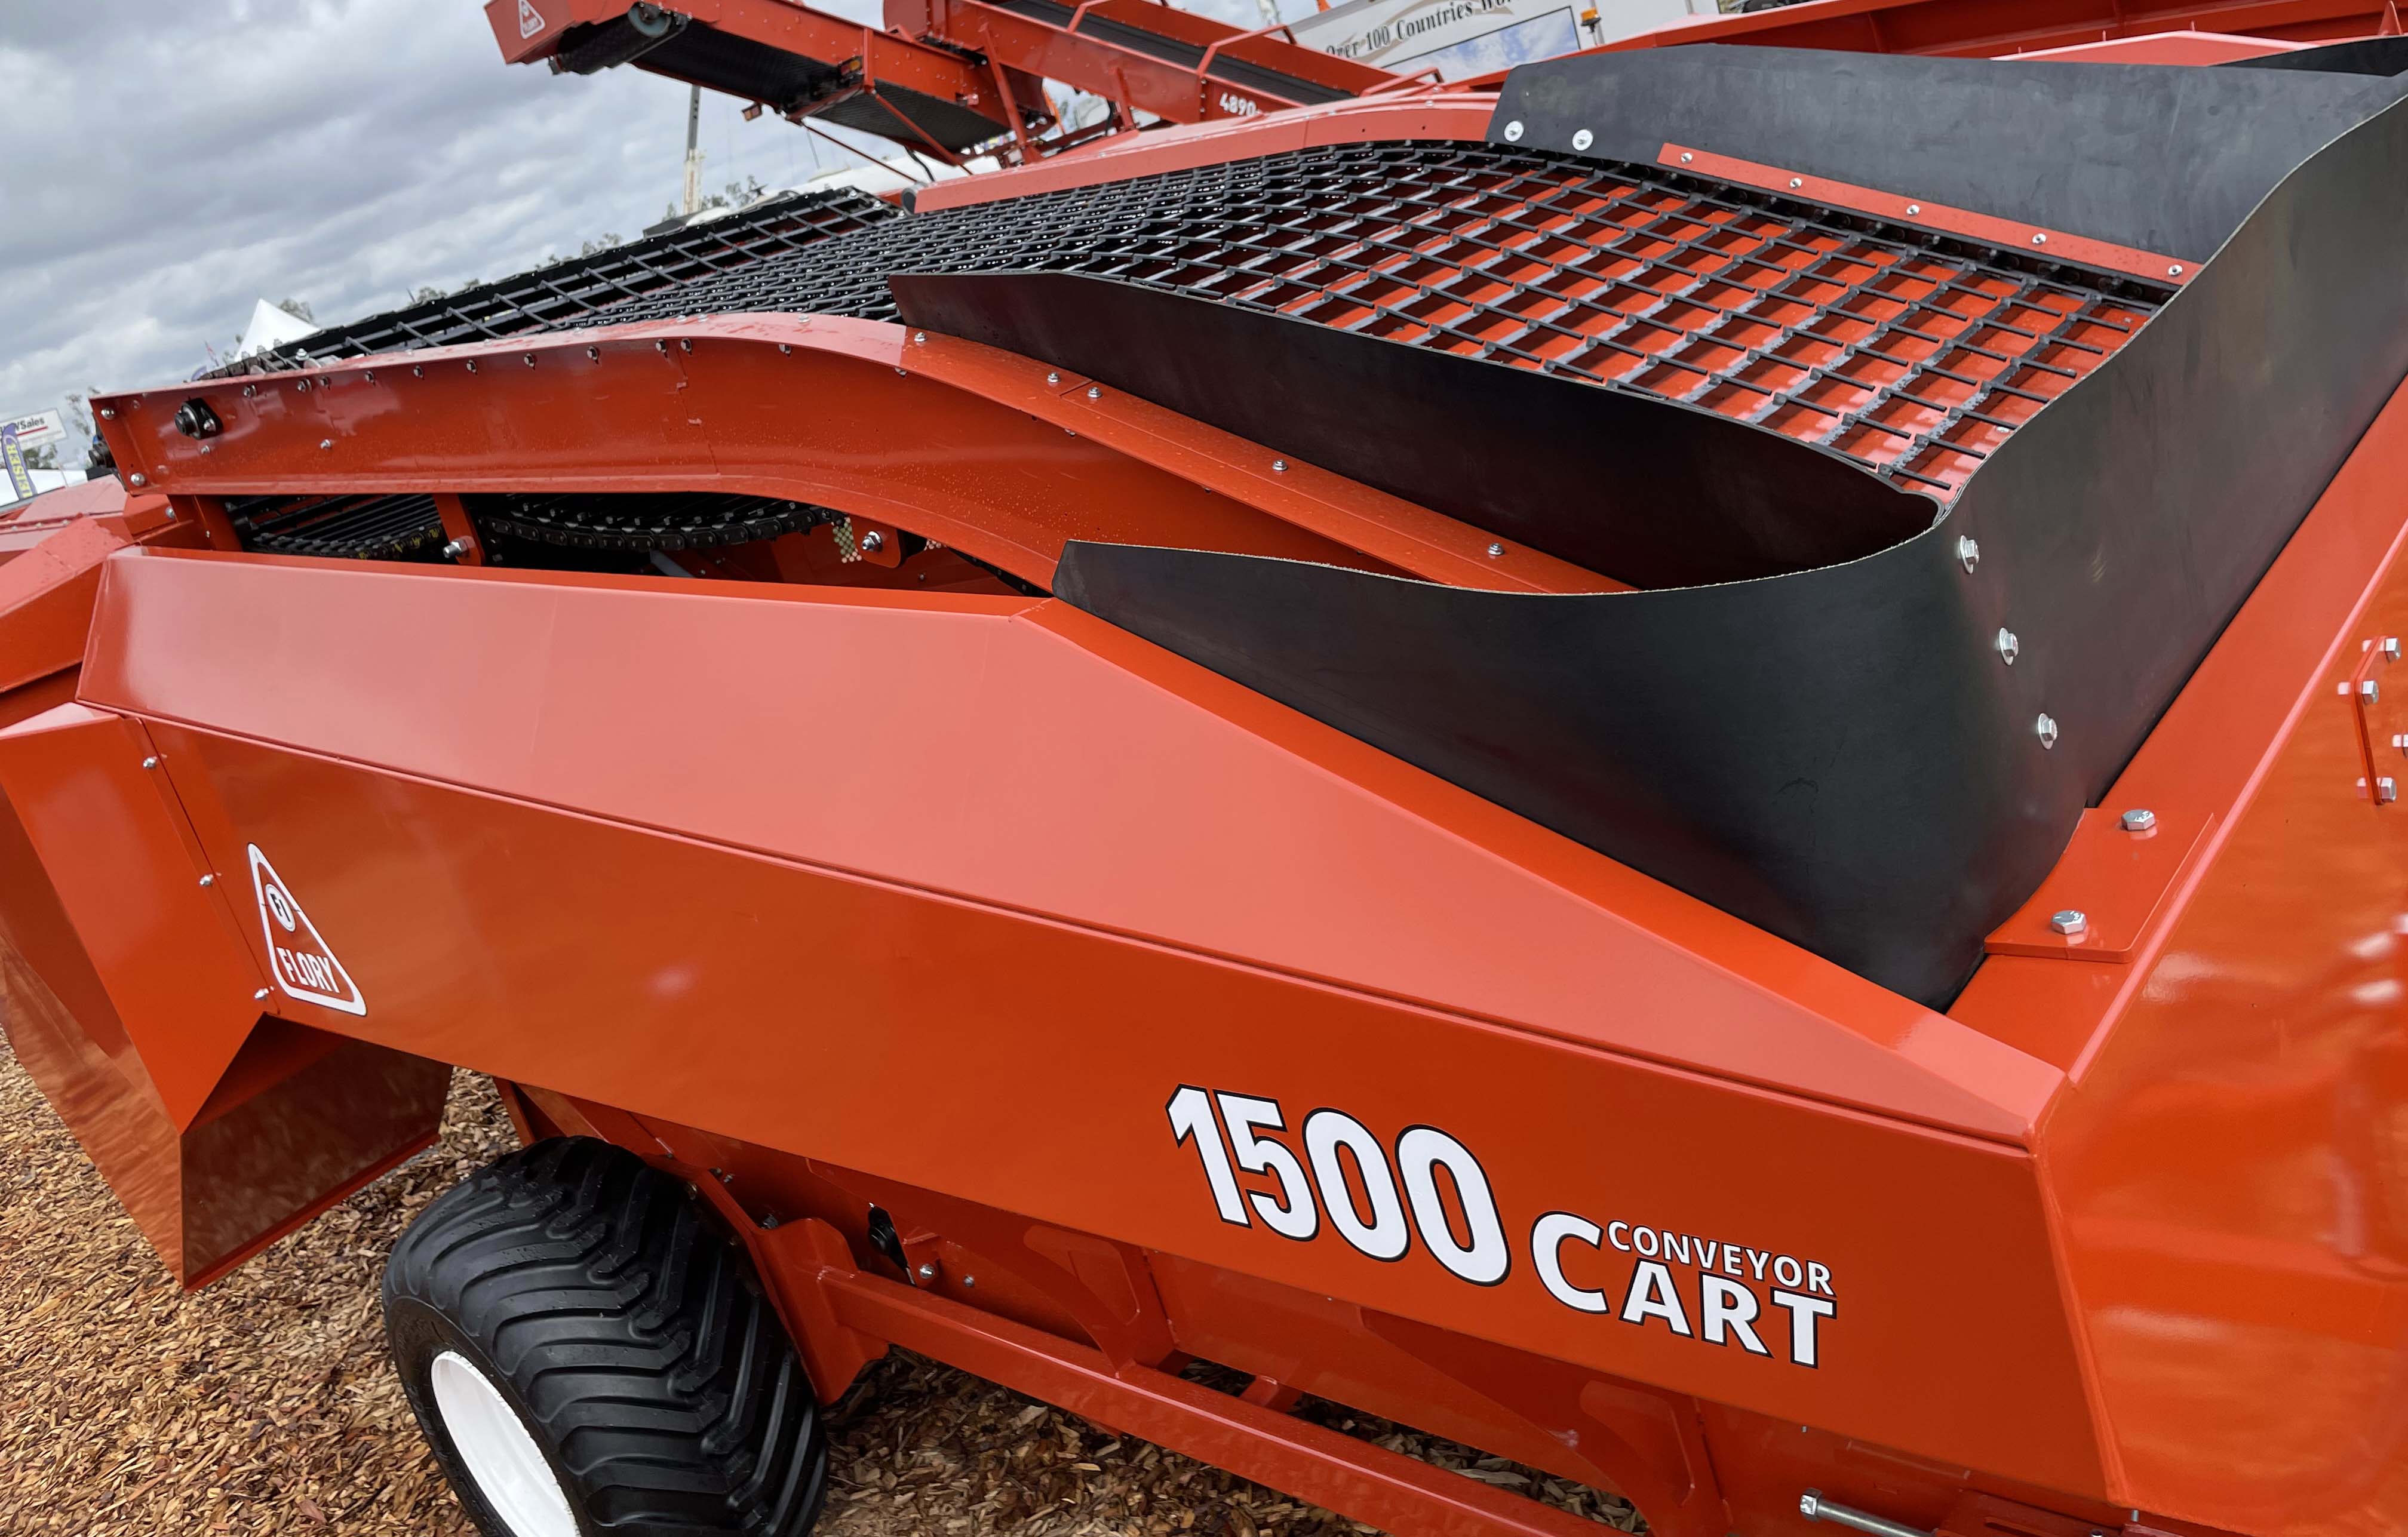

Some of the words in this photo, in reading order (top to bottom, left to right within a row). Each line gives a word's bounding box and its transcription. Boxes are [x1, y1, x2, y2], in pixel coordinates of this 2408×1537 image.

[1366, 25, 1390, 50] 100
[1396, 1, 1473, 40] Countries
[276, 946, 340, 994] FLORY
[1165, 1083, 1512, 1287] 1500
[1530, 1210, 1838, 1369] CART
[1607, 1219, 1838, 1296] CONVEYOR
